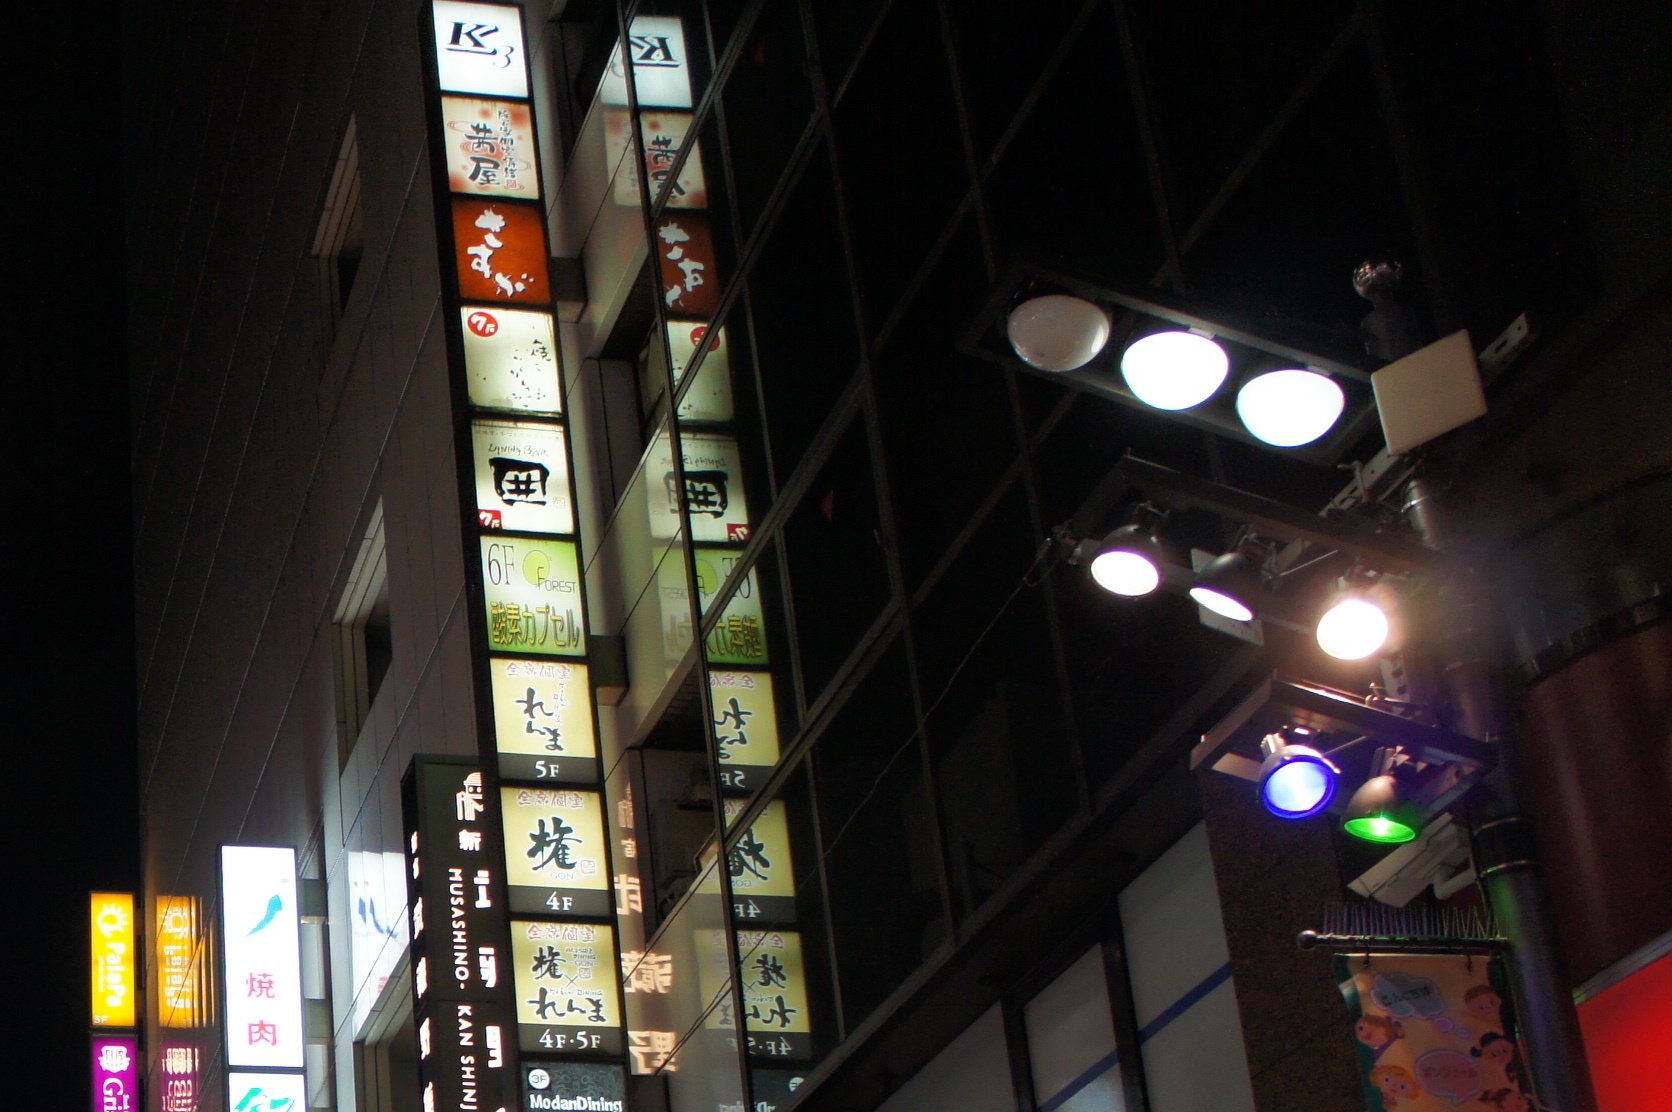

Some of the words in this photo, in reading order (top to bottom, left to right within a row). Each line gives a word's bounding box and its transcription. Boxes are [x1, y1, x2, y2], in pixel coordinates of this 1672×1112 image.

[488, 543, 516, 586] 6F
[536, 567, 577, 593] FOREST
[490, 601, 579, 648] 酸素カプセル
[535, 761, 560, 777] 5F
[550, 872, 574, 880] GON
[546, 891, 573, 911] 4F
[245, 971, 278, 1047] 焼肉
[457, 1005, 474, 1047] KAN
